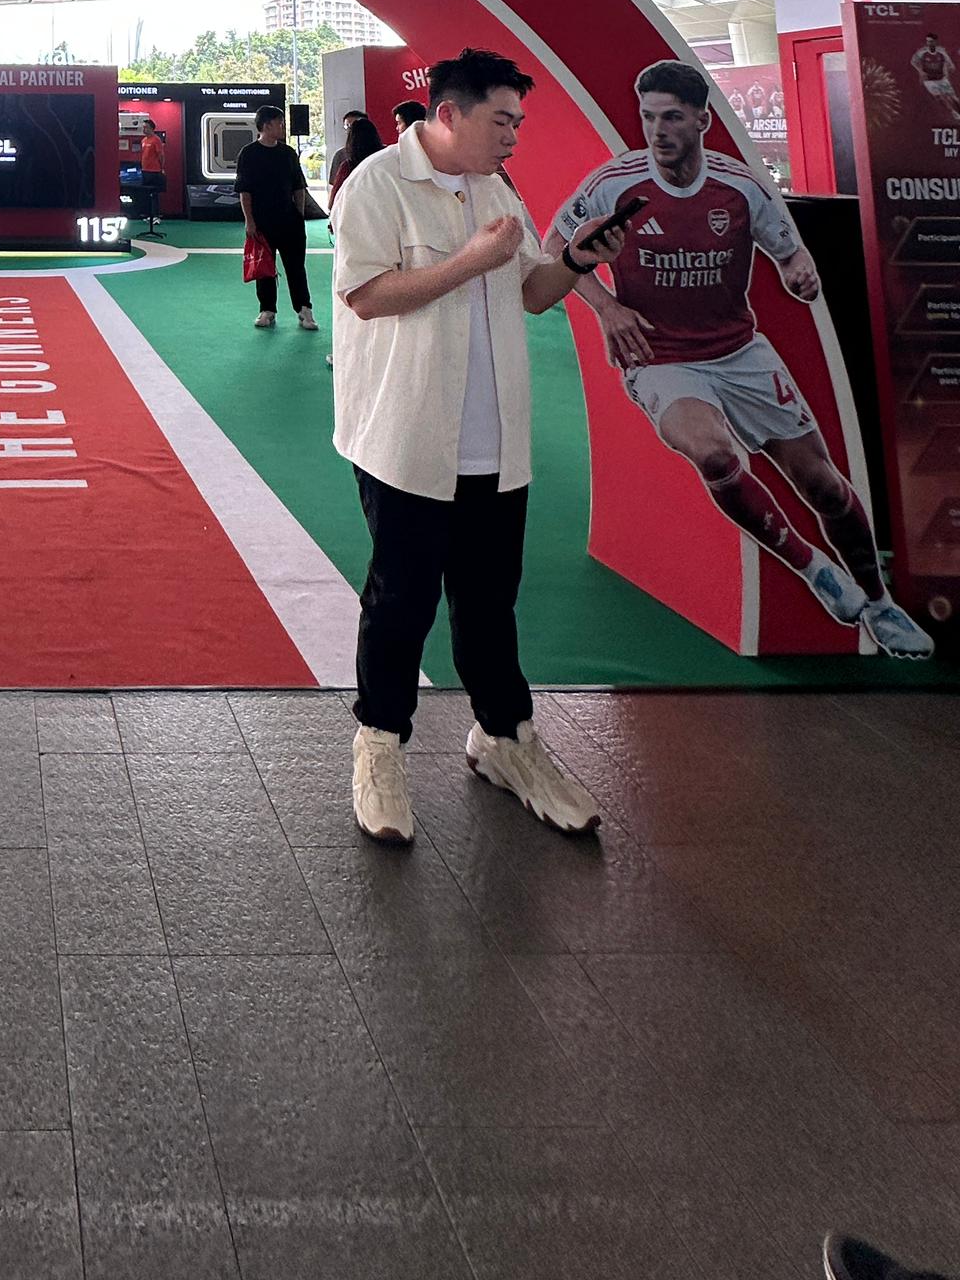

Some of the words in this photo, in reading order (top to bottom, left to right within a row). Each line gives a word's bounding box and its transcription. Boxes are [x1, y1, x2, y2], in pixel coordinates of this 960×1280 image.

[864, 4, 899, 17] TCL
[20, 71, 84, 87] PARTNER
[752, 118, 788, 131] ARSENA
[931, 128, 960, 145] TCL
[944, 147, 958, 158] MY
[638, 247, 735, 269] Emirates
[654, 270, 675, 288] FLY
[680, 269, 723, 288] BETTER
